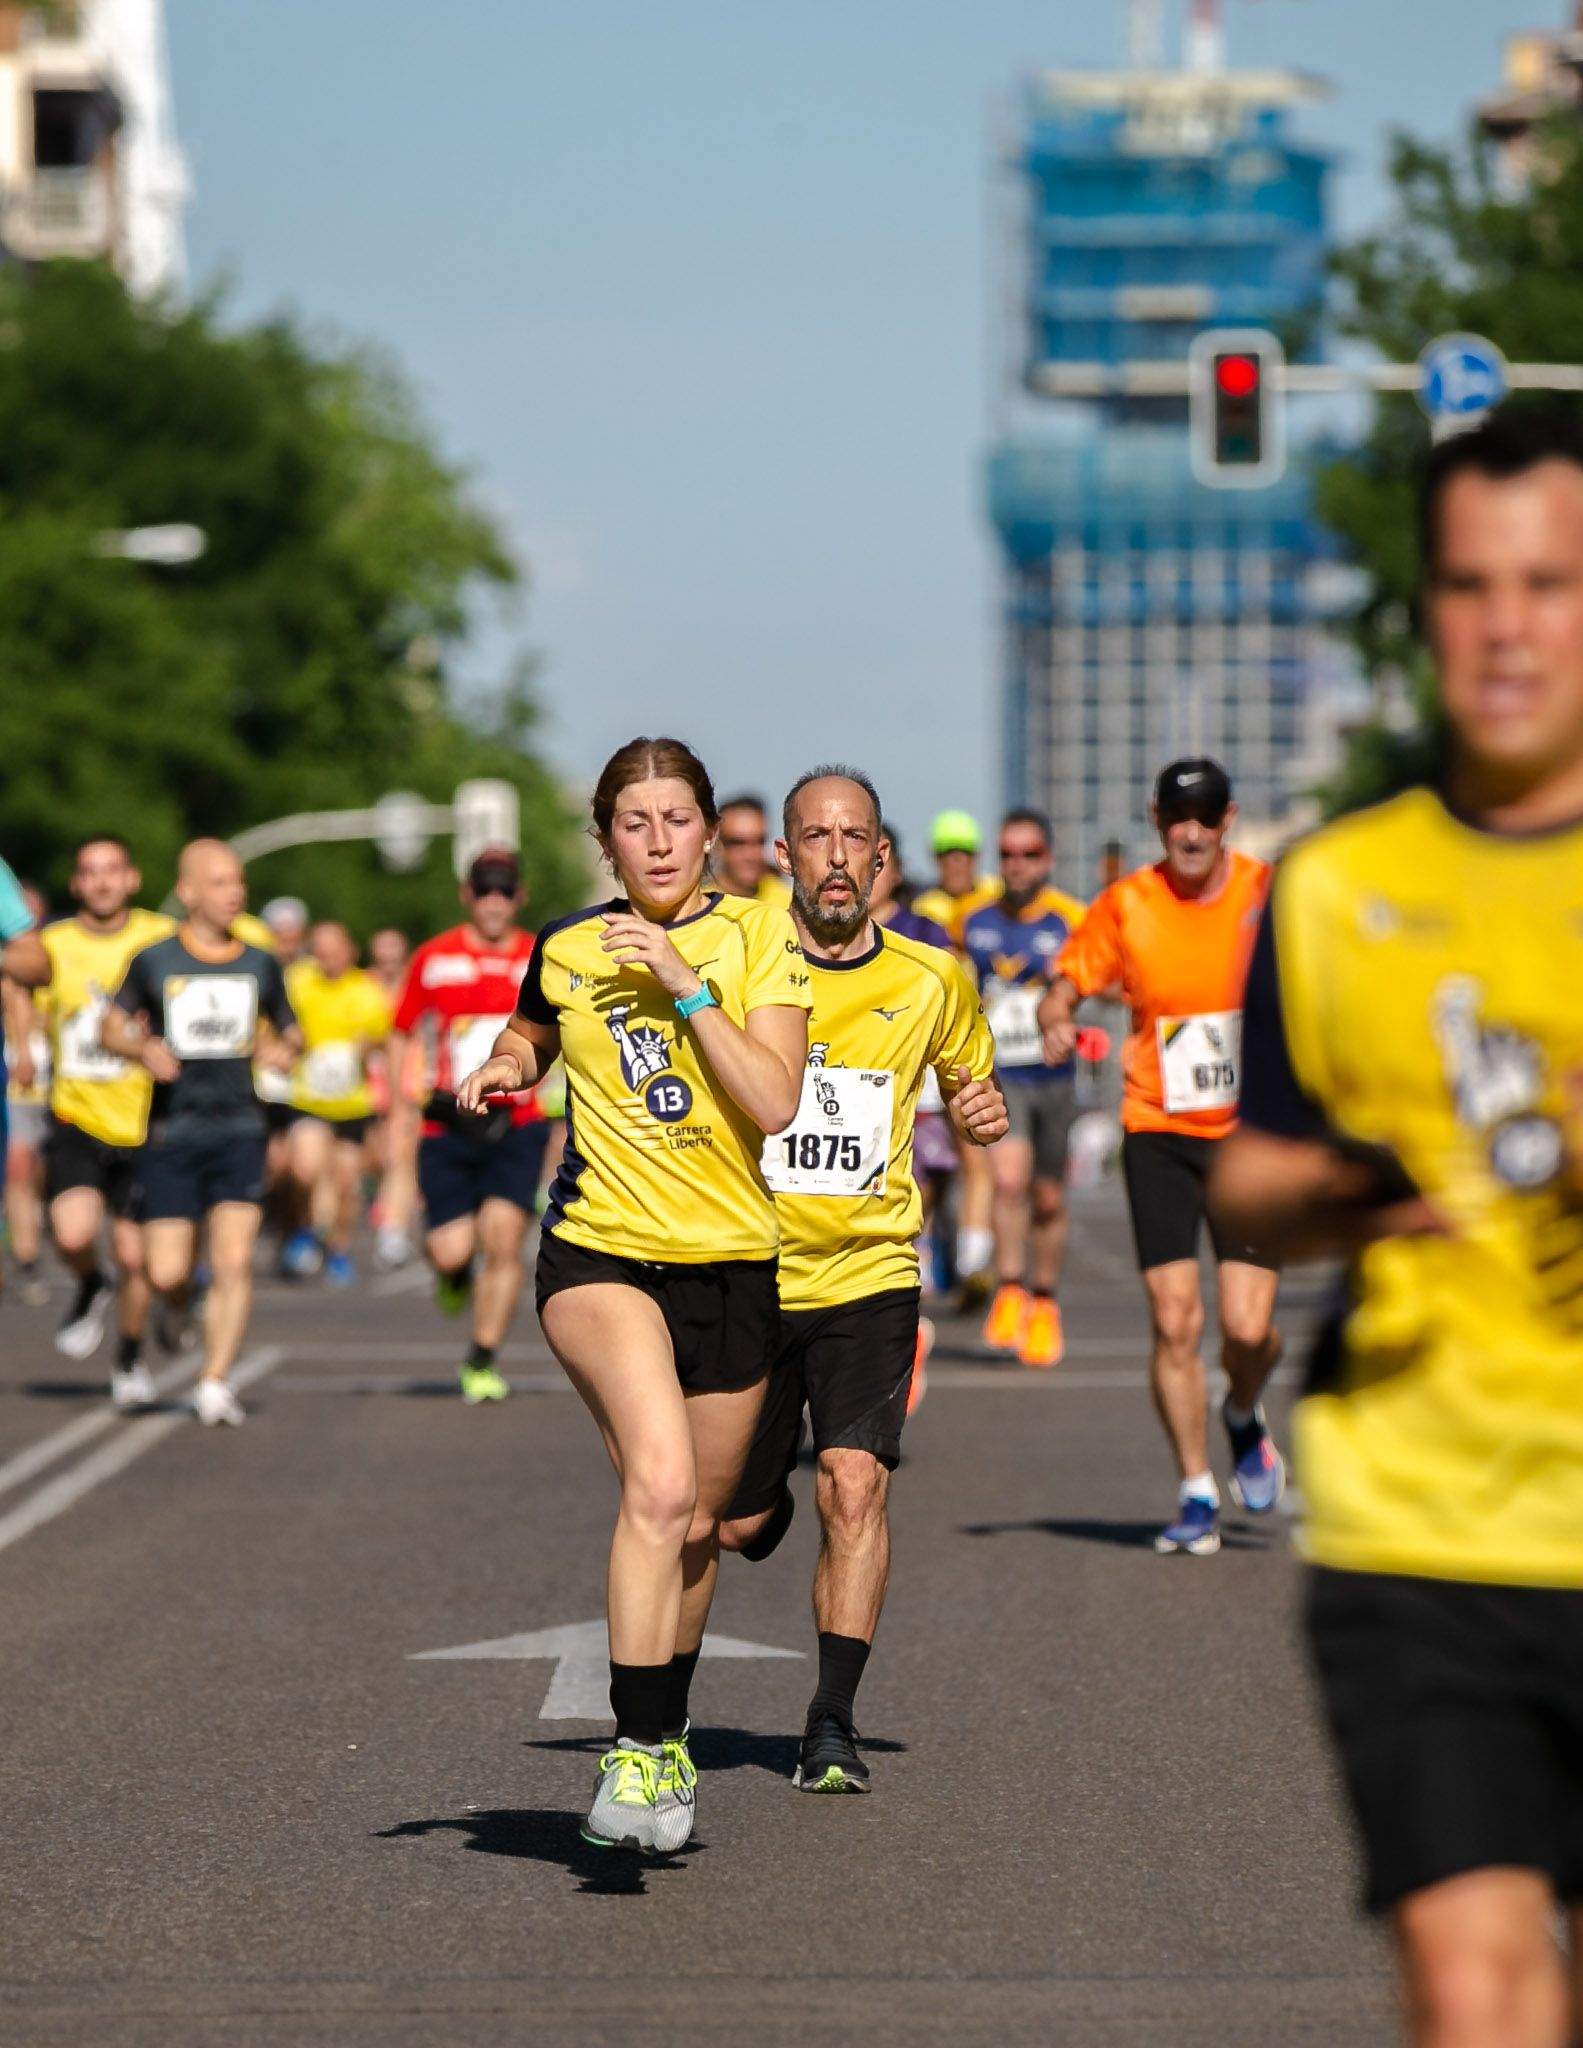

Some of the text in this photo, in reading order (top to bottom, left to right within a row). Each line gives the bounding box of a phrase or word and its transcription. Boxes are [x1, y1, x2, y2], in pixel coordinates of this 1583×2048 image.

[653, 1086, 684, 1112] 13
[826, 1103, 837, 1113] 13
[666, 1125, 712, 1137] Carrera
[669, 1136, 713, 1150] Liberty
[782, 1133, 861, 1172] 1875
